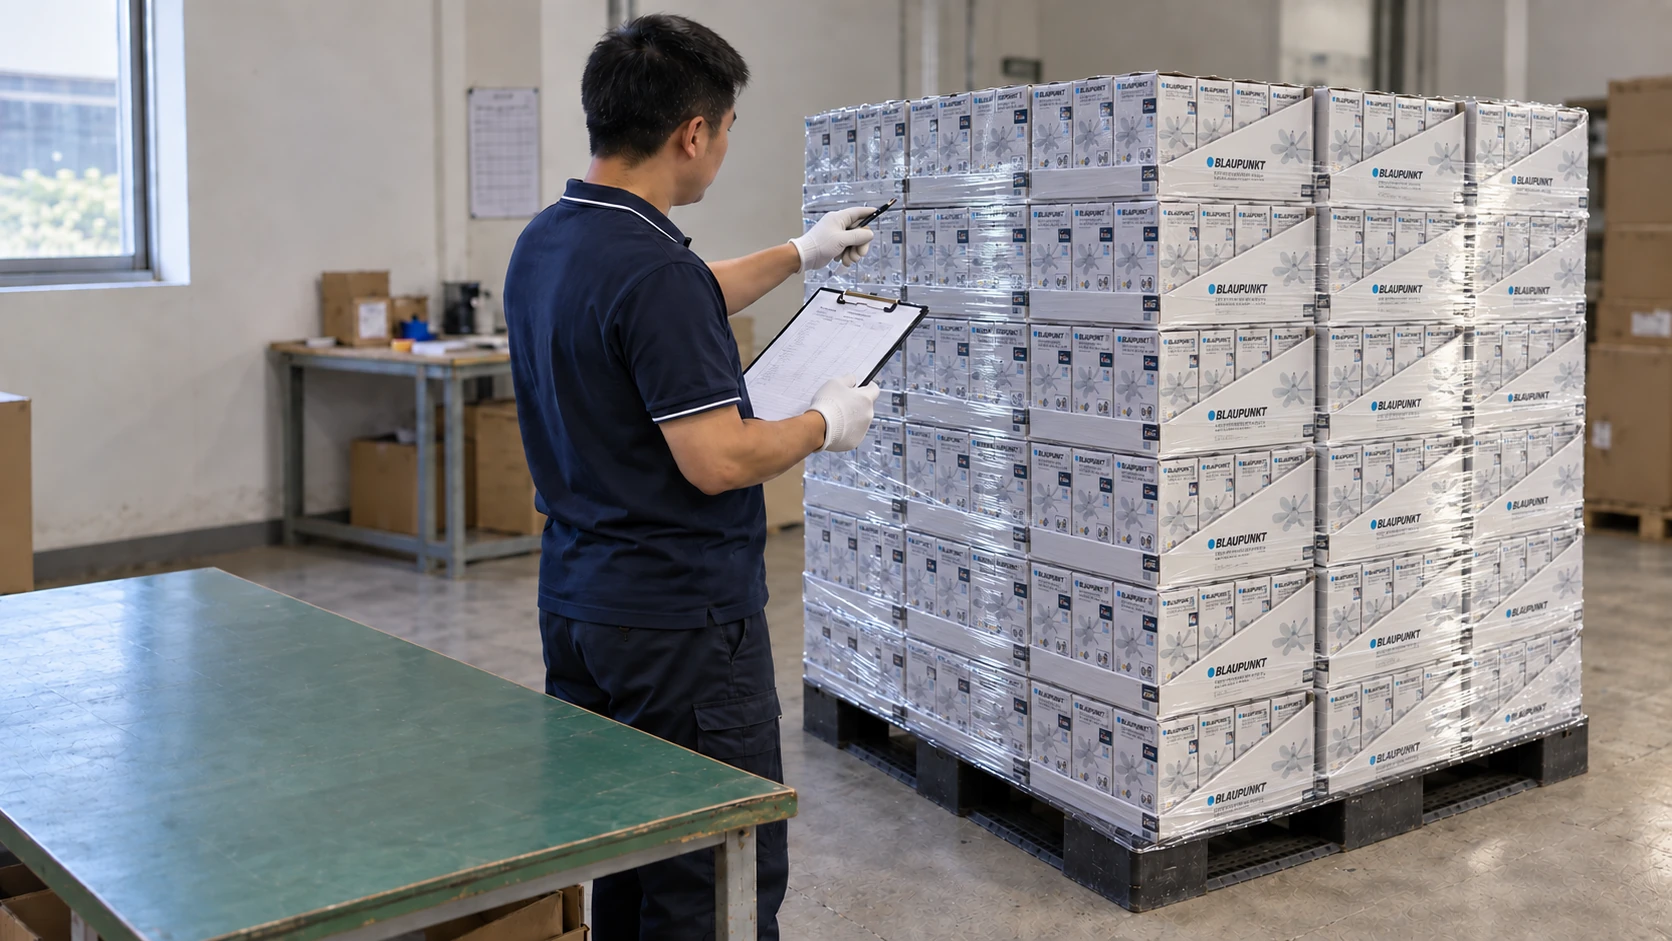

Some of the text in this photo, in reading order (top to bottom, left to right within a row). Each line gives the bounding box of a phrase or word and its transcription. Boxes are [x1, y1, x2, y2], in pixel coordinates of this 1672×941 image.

[1214, 158, 1266, 170] BLAUPUNKT
[1379, 168, 1423, 180] BLAUPUNKT
[1517, 177, 1553, 186] BLAUPUNKT
[1216, 284, 1268, 294] BLAUPUNKT
[1379, 284, 1423, 294] BLAUPUNKT
[1514, 286, 1550, 295] BLAUPUNKT
[1514, 391, 1550, 402] BLAUPUNKT
[1378, 398, 1422, 411] BLAUPUNKT
[1216, 407, 1267, 420] BLAUPUNKT
[1512, 496, 1549, 510] BLAUPUNKT
[1377, 513, 1421, 529] BLAUPUNKT
[1216, 532, 1267, 548] BLAUPUNKT
[1512, 601, 1548, 617] BLAUPUNKT
[1376, 629, 1421, 647] BLAUPUNKT
[1216, 658, 1267, 676] BLAUPUNKT
[1376, 742, 1420, 764] BLAUPUNKT
[1215, 782, 1267, 804] BLAUPUNKT
